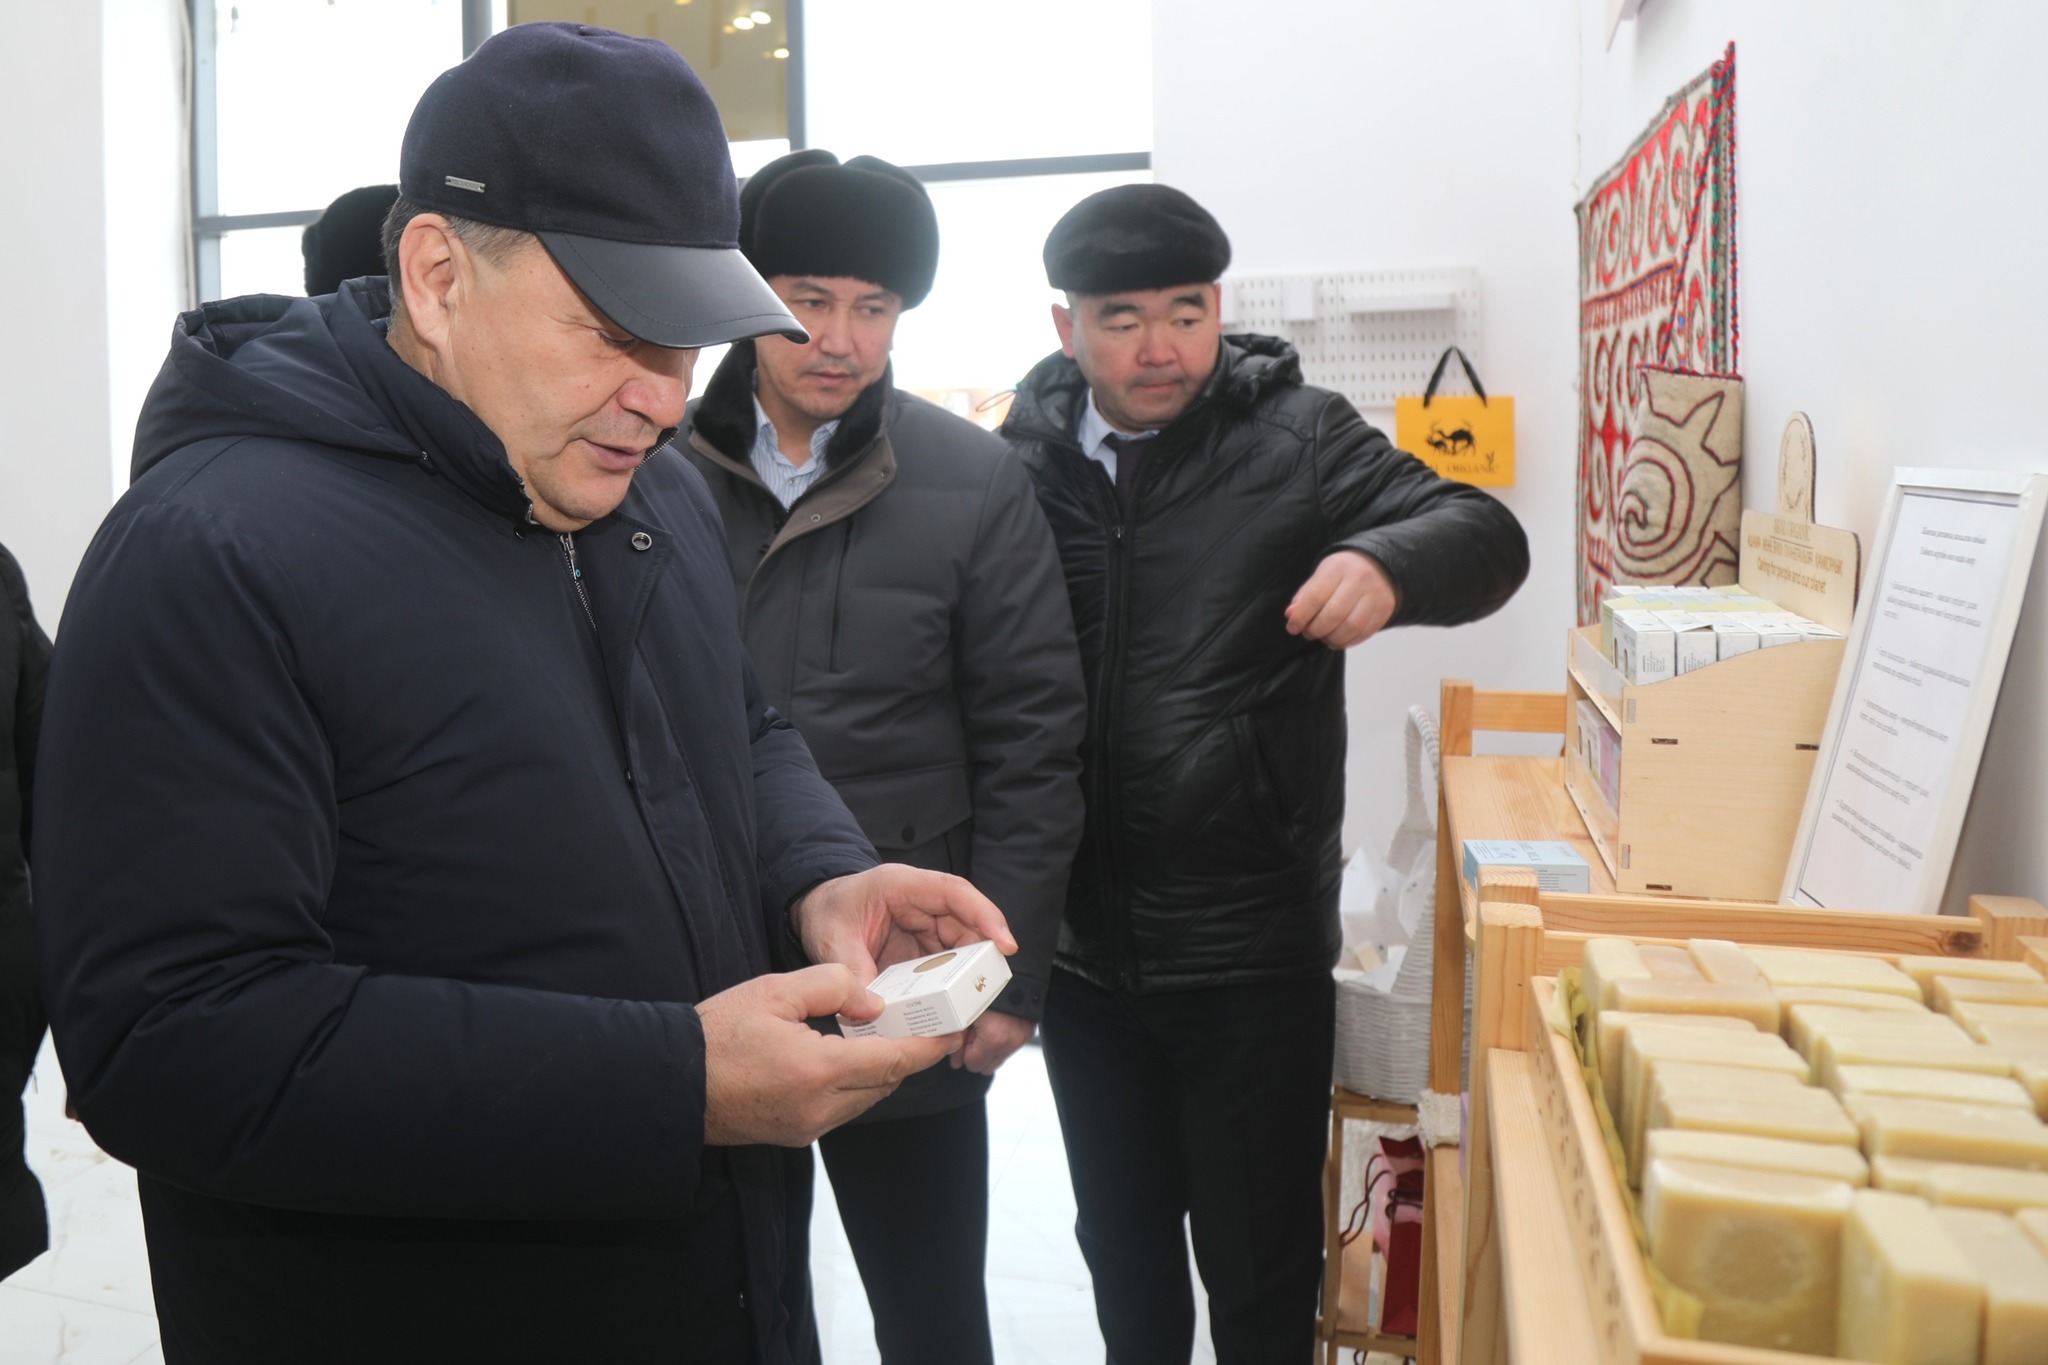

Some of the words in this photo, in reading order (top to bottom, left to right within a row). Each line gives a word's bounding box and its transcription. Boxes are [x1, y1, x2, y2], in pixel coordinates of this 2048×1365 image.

[1446, 463, 1500, 474] ORGANIC
[1758, 557, 1771, 575] Caring
[1777, 565, 1792, 582] people
[1792, 568, 1802, 584] and
[1810, 575, 1826, 594] planet
